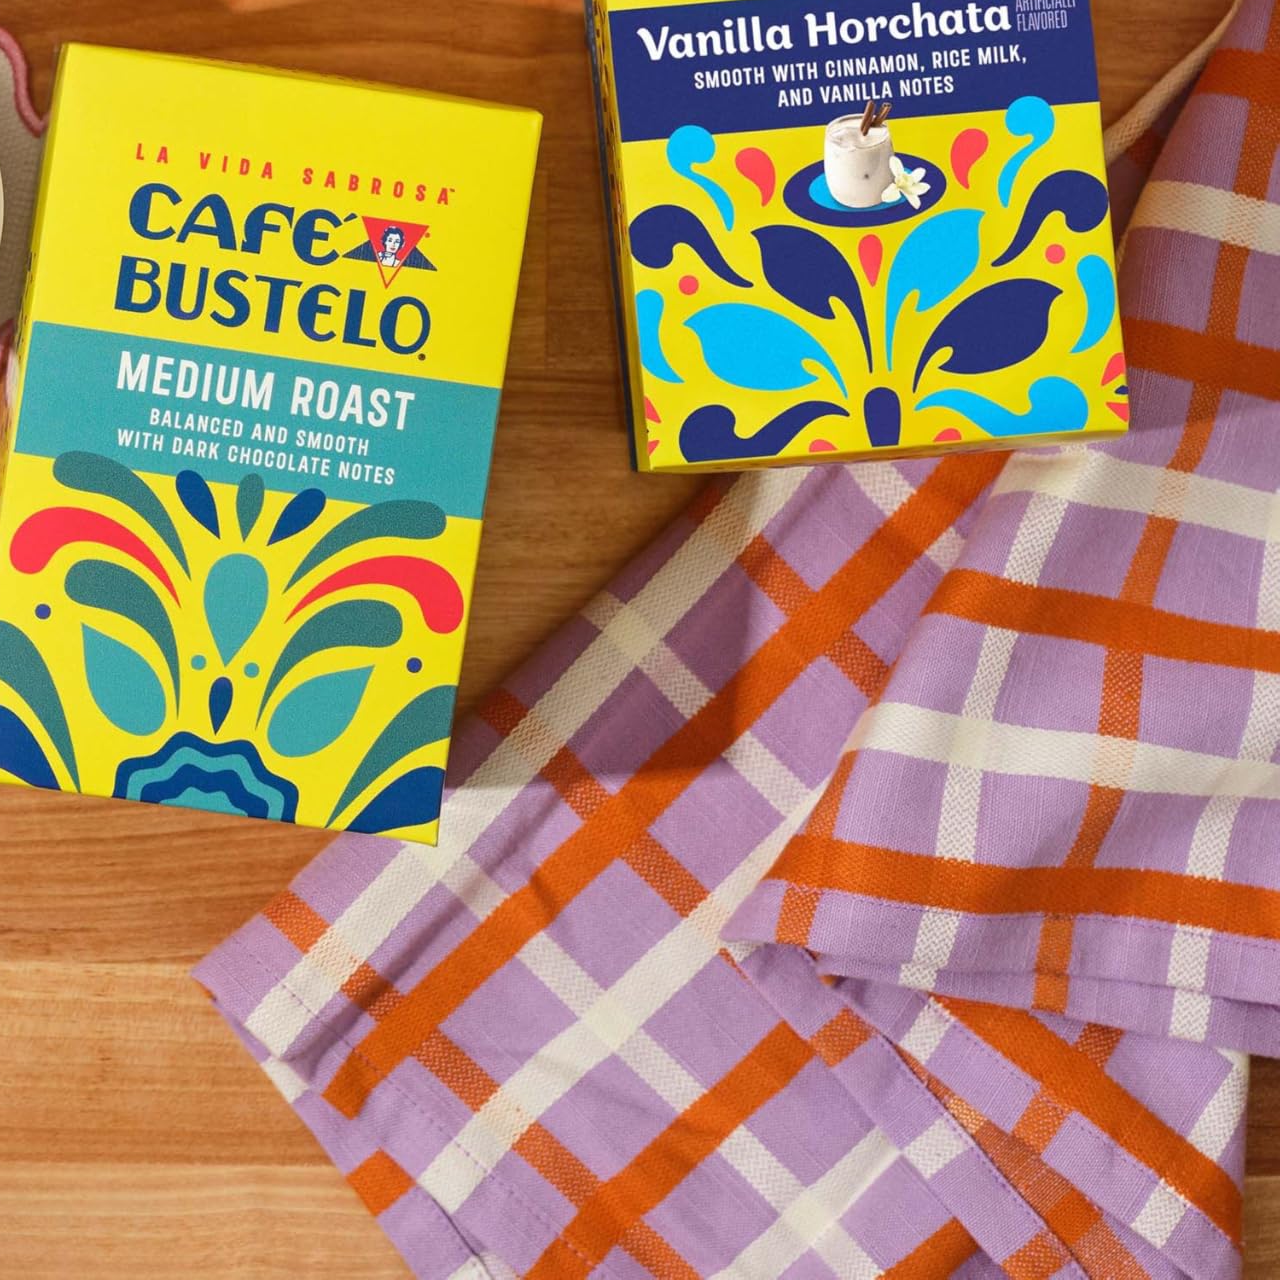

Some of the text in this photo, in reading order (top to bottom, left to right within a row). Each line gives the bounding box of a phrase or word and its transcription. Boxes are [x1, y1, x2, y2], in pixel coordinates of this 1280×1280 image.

[637, 2, 1011, 60] Vanilla Horchata
[1017, 10, 1067, 32] FLAVORED
[695, 45, 1026, 89] SMOOTH WITH CINNAMON, RICE MILK,
[778, 76, 953, 107] AND VANILLA NOTES
[135, 142, 168, 163] LA
[199, 151, 273, 179] VIDA
[117, 351, 415, 430] MEDIUM ROAST
[150, 408, 368, 455] BALANCED AND SMOOTH
[118, 429, 394, 485] WITH DARK CHOCOLATE NOTES
